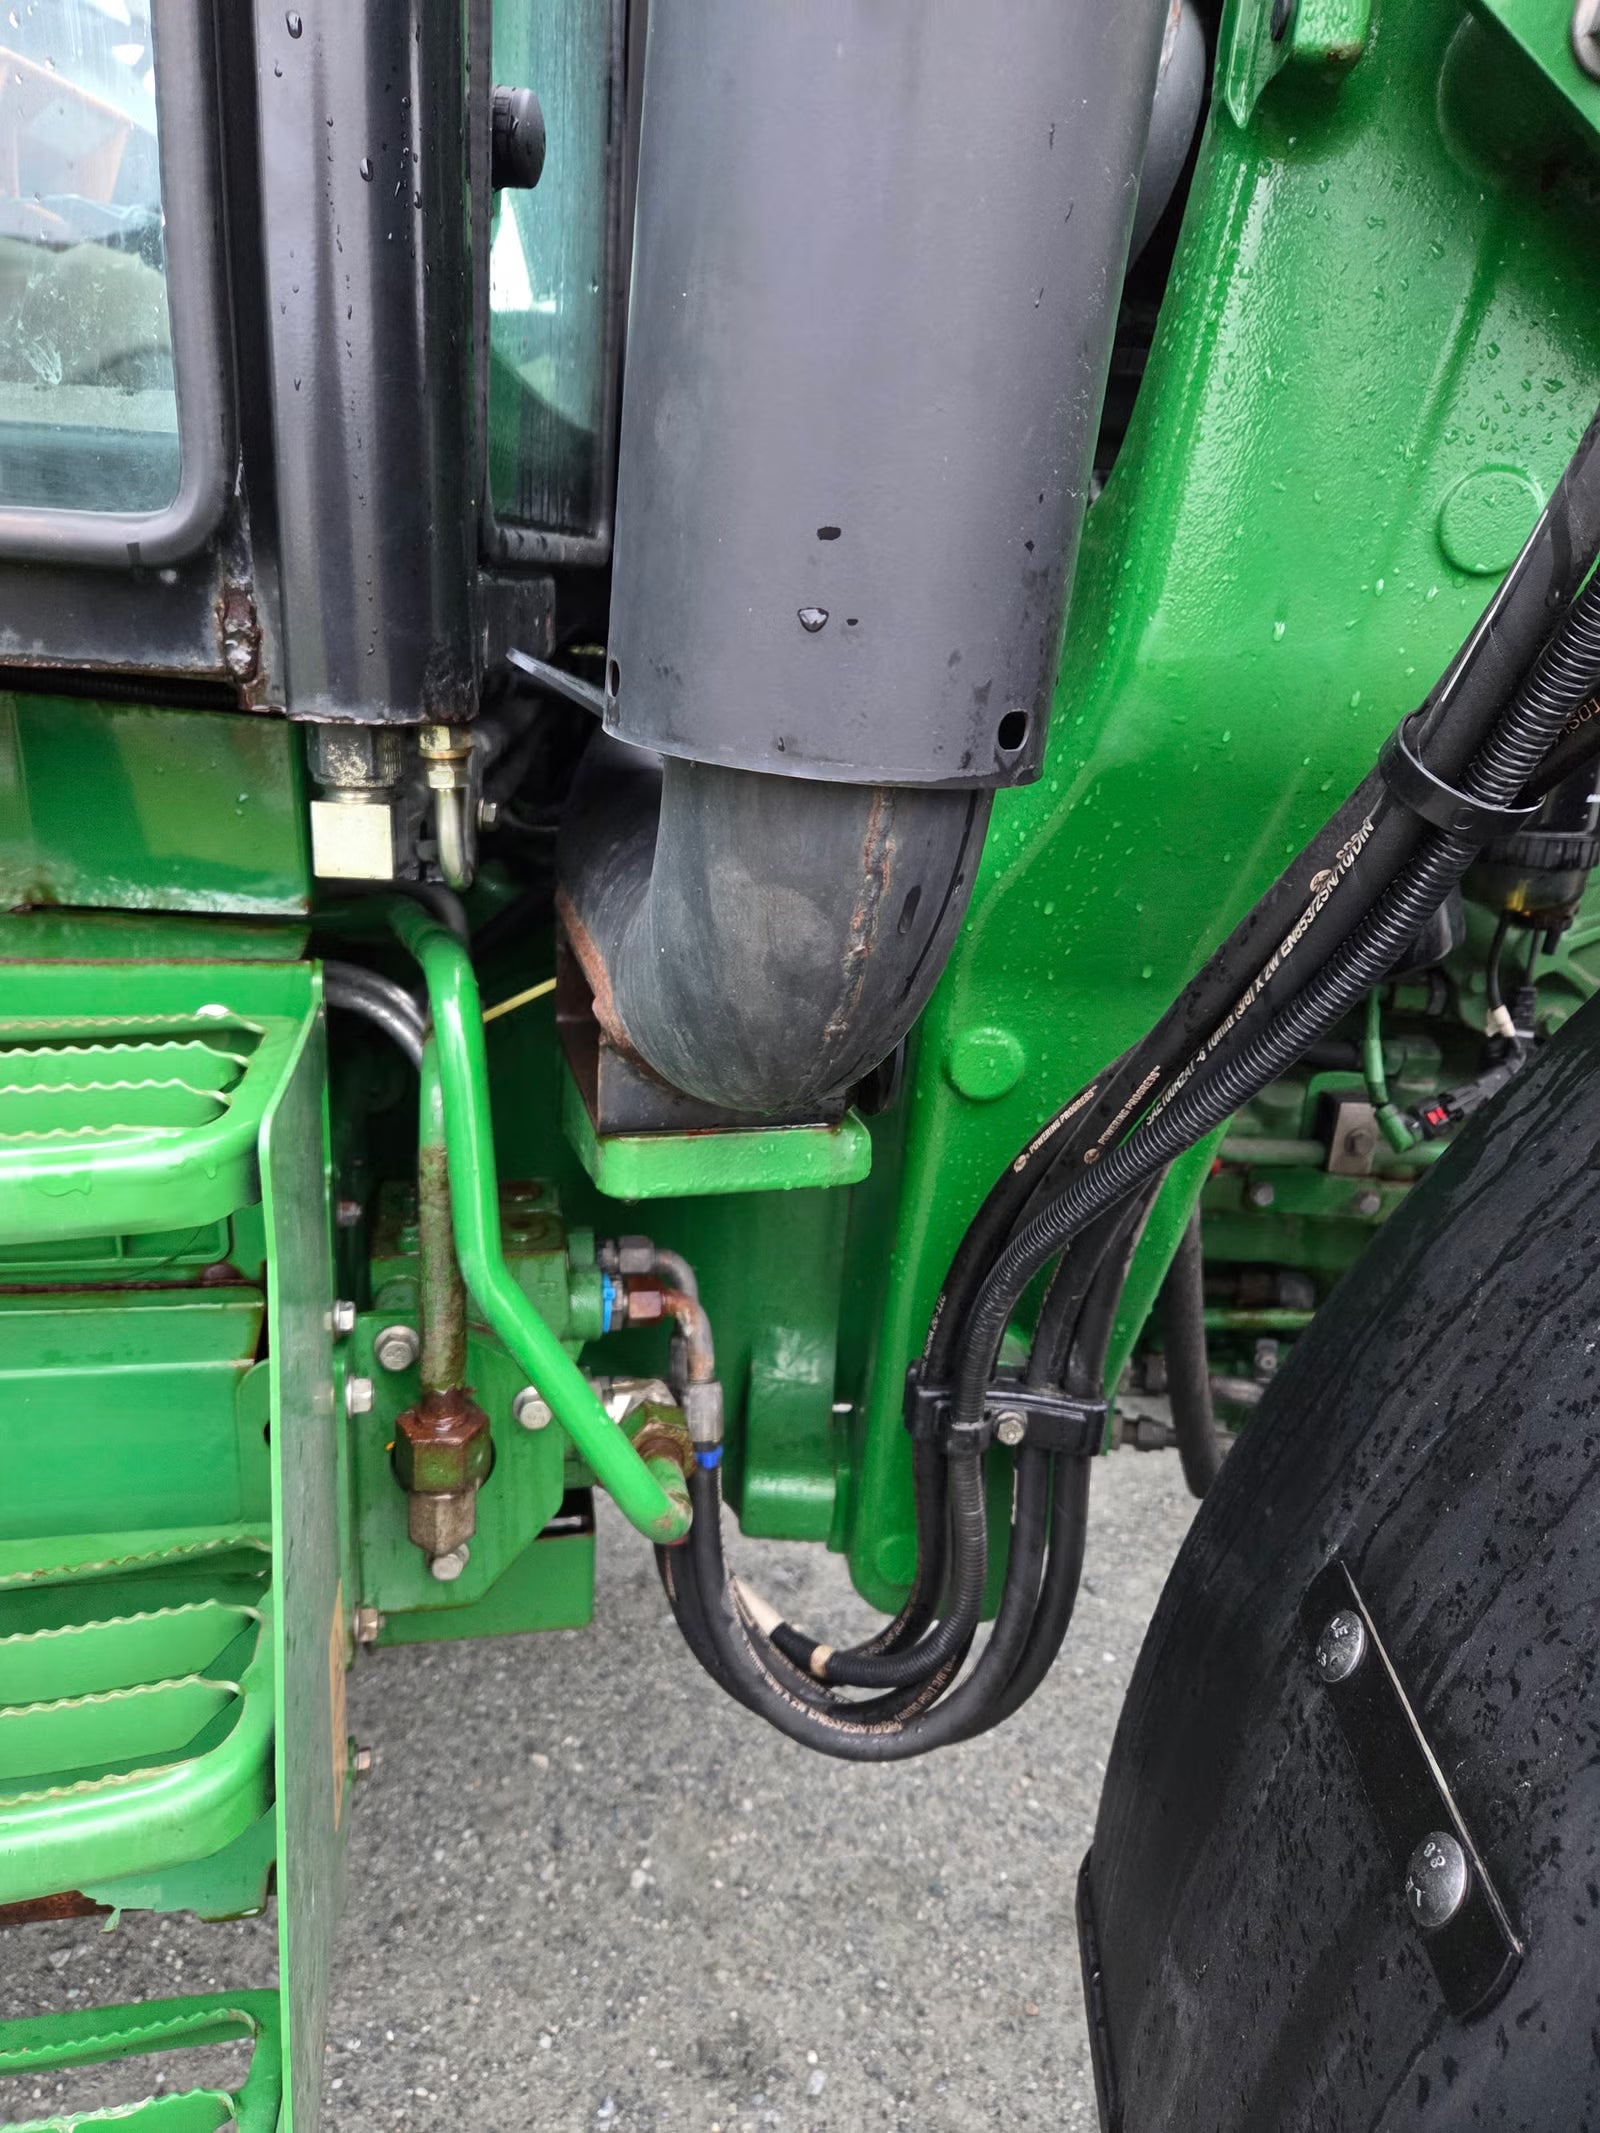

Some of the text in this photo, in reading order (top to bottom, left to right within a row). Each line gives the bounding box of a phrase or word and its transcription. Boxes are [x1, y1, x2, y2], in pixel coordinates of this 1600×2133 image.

[1263, 952, 1280, 982] 2W
[1029, 1117, 1061, 1154] POWERING
[1098, 1109, 1130, 1146] POWERING
[1423, 1842, 1446, 1868] 8.8
